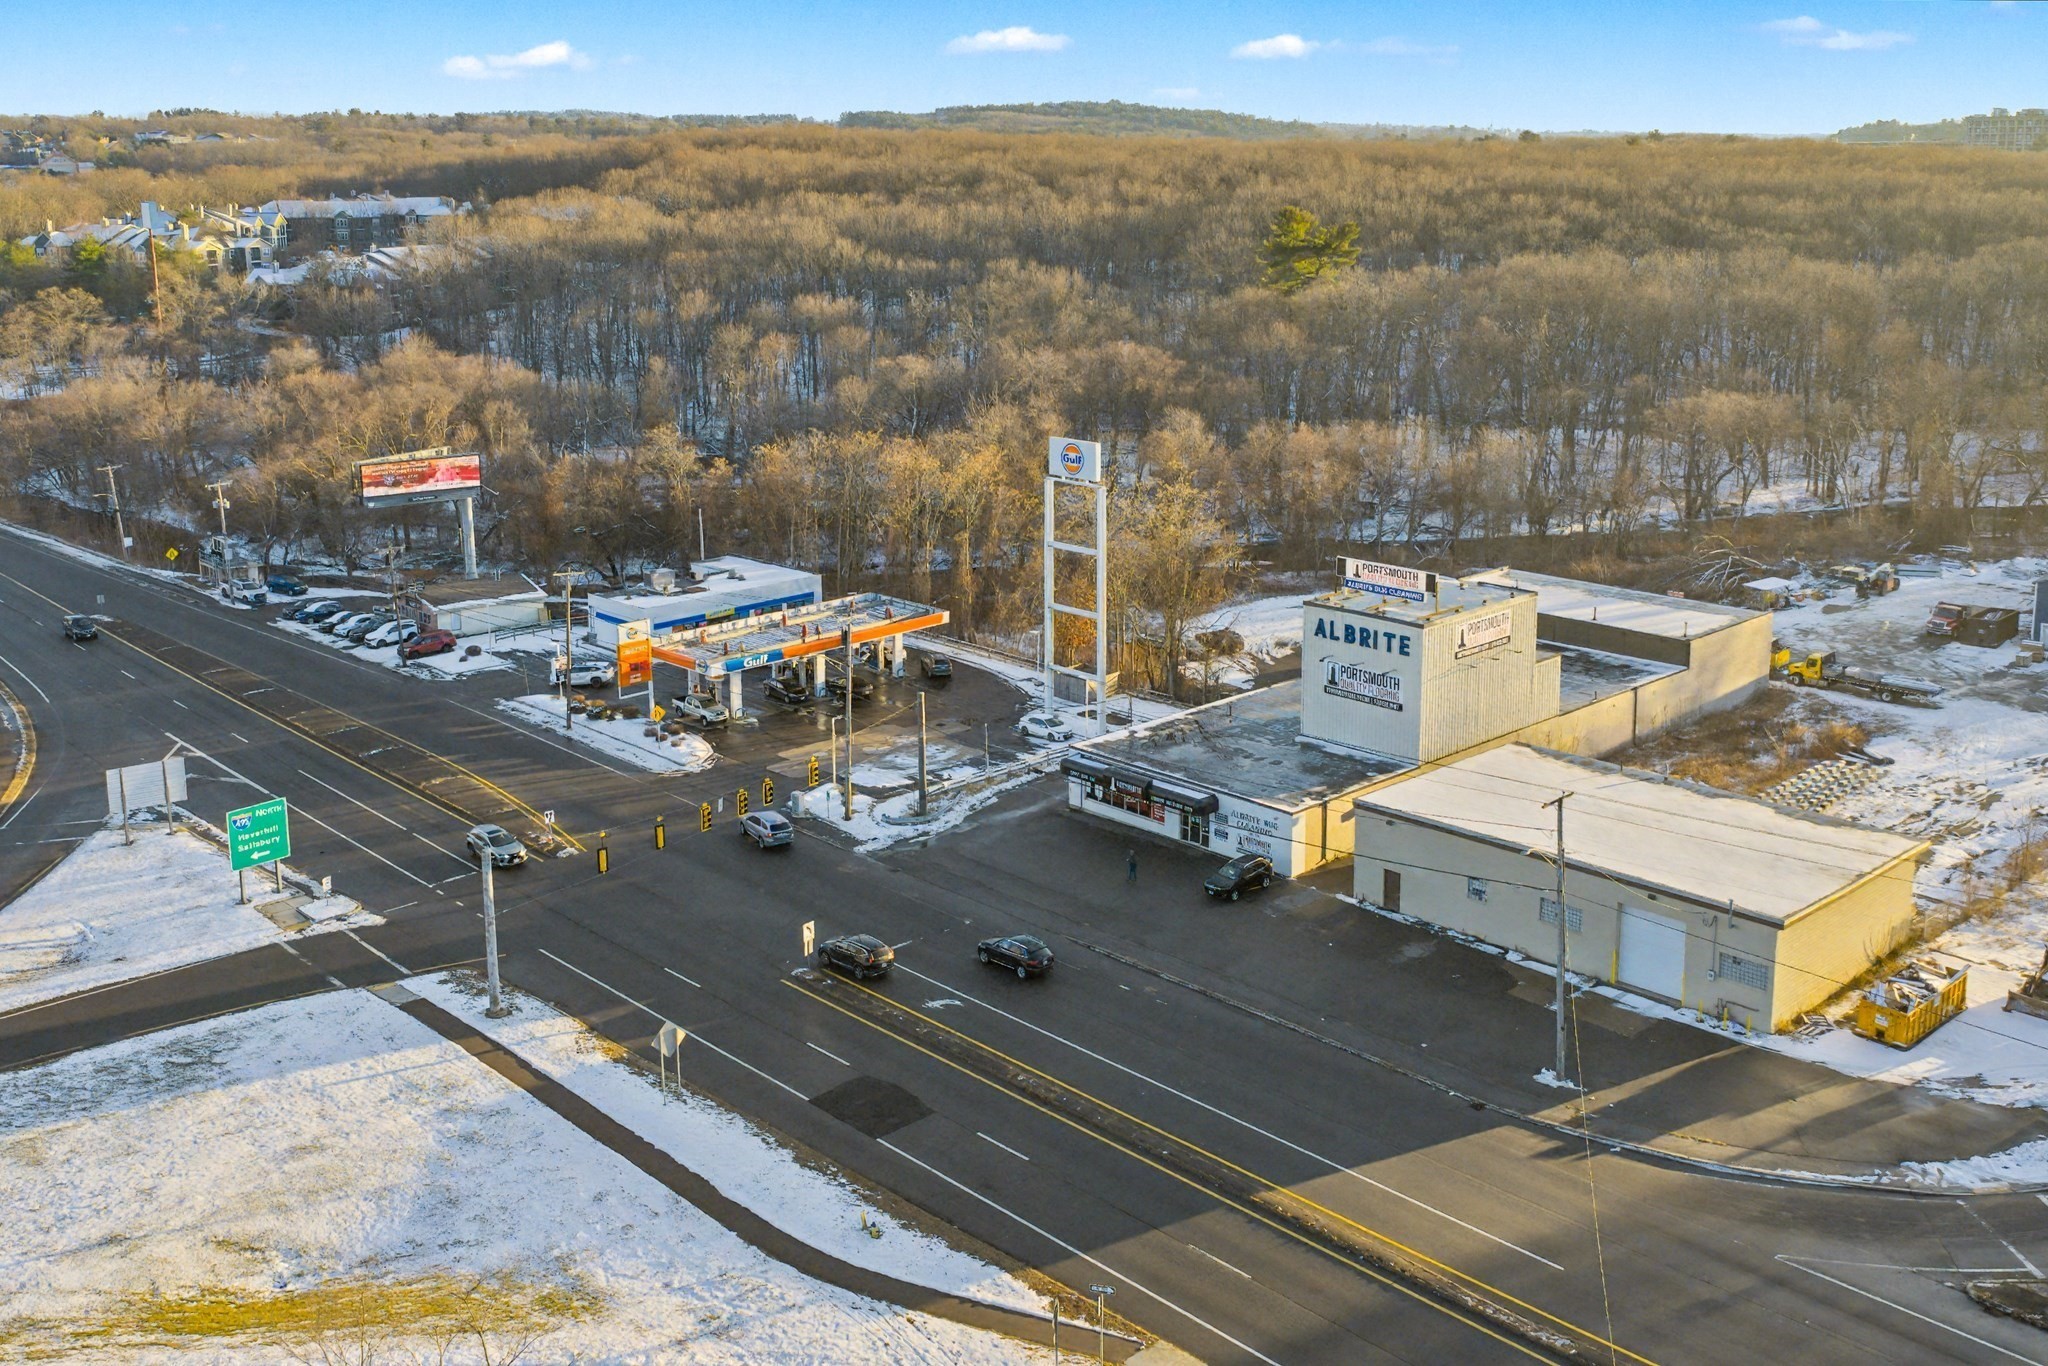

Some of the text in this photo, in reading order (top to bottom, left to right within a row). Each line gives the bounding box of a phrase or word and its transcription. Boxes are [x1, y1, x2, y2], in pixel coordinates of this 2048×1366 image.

[1063, 453, 1082, 465] Gulf
[1362, 563, 1419, 582] PORTSMOUTH
[1388, 588, 1423, 601] CLEANING
[1314, 617, 1411, 657] ALBRITE
[743, 653, 769, 668] Gulf
[1340, 665, 1400, 691] PORTSMOUTH
[255, 805, 282, 817] NORTH
[238, 825, 279, 841] Haverhill
[238, 836, 280, 852] Salisbury
